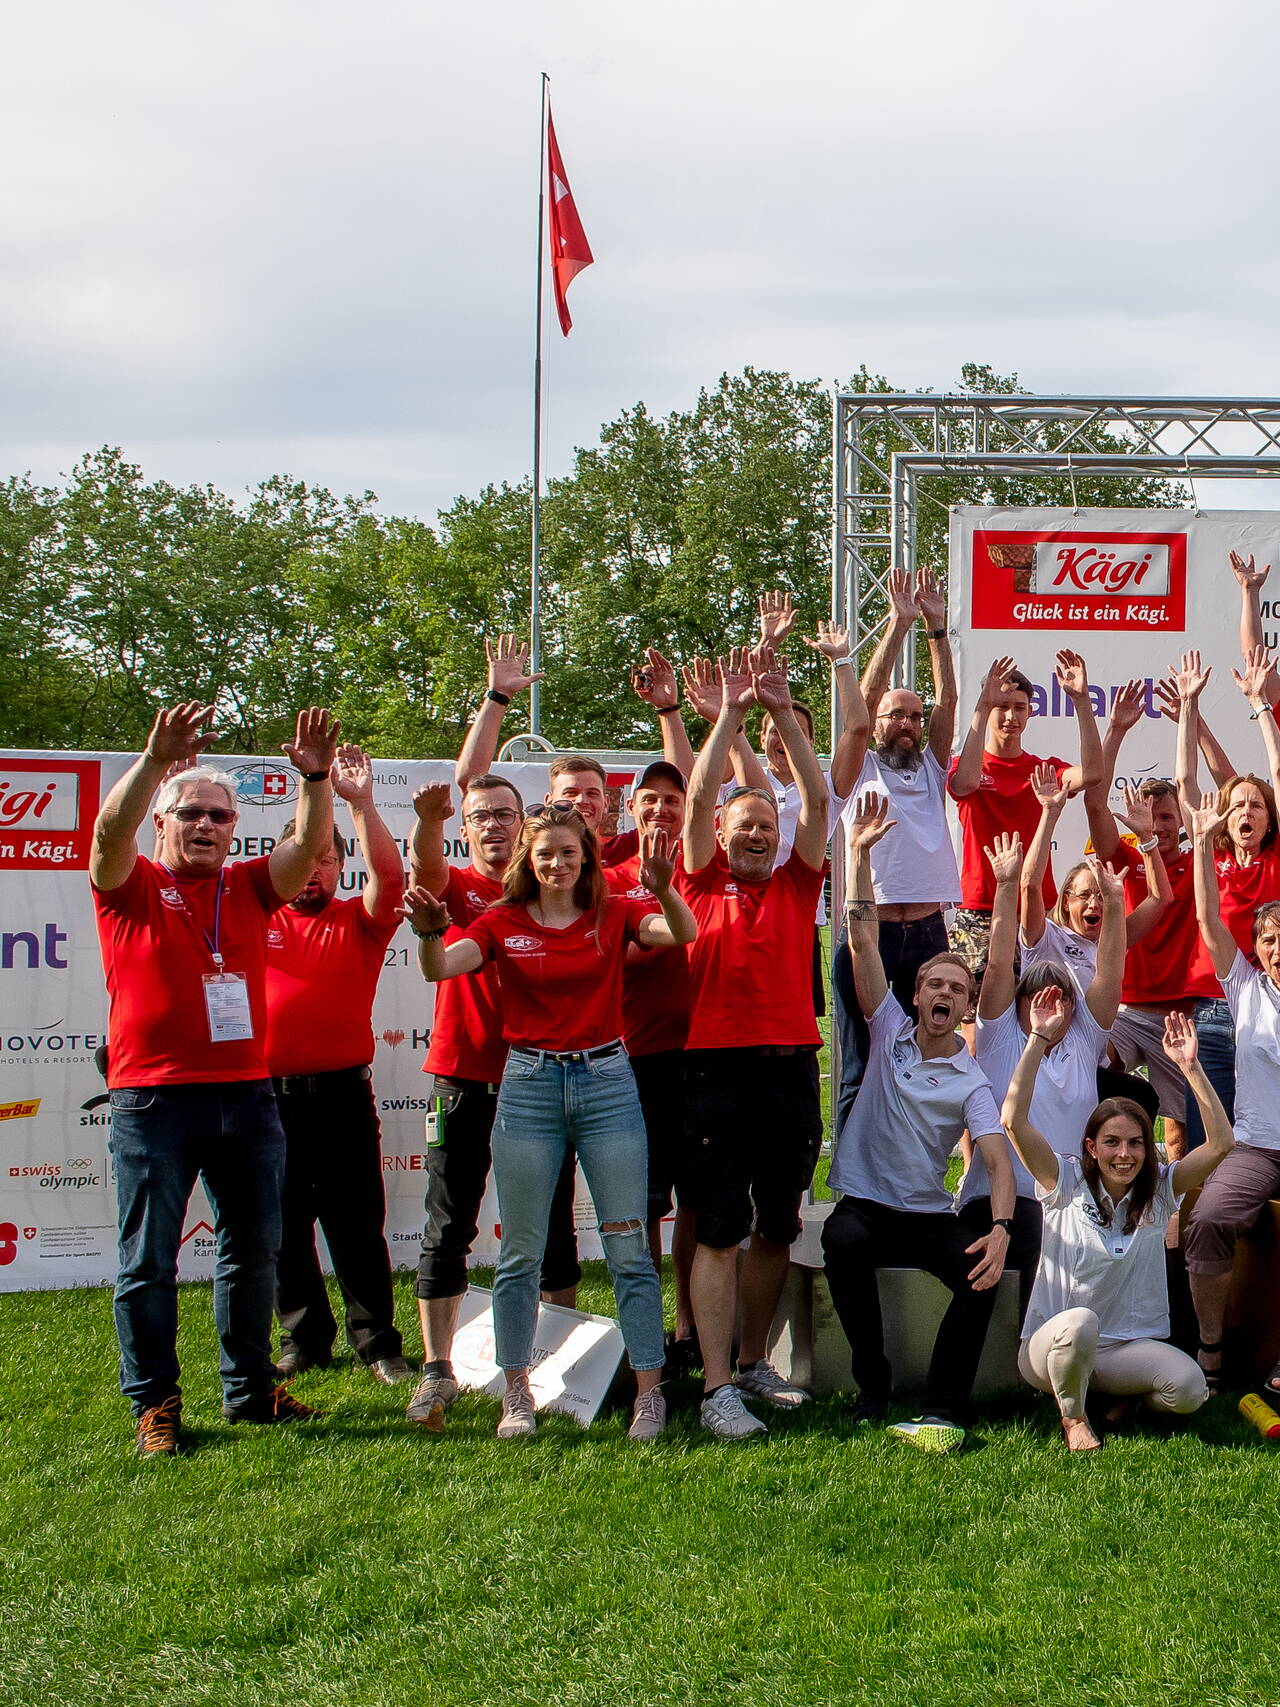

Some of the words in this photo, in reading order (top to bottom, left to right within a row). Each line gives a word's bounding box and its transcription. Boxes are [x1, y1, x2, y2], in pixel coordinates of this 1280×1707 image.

[1052, 548, 1152, 593] Kägi
[1013, 604, 1065, 621] Glück
[1069, 604, 1090, 621] ist
[1093, 605, 1121, 621] ein
[1125, 605, 1170, 625] Kägi.
[1031, 673, 1162, 718] alat
[22, 841, 78, 863] Kägi.
[228, 837, 276, 856] DER
[385, 948, 408, 967] 21
[0, 1104, 36, 1118] erBar
[381, 1095, 427, 1110] swiss
[22, 1163, 61, 1176] swiss
[40, 1173, 100, 1190] olympic
[392, 1232, 423, 1242] Stadt
